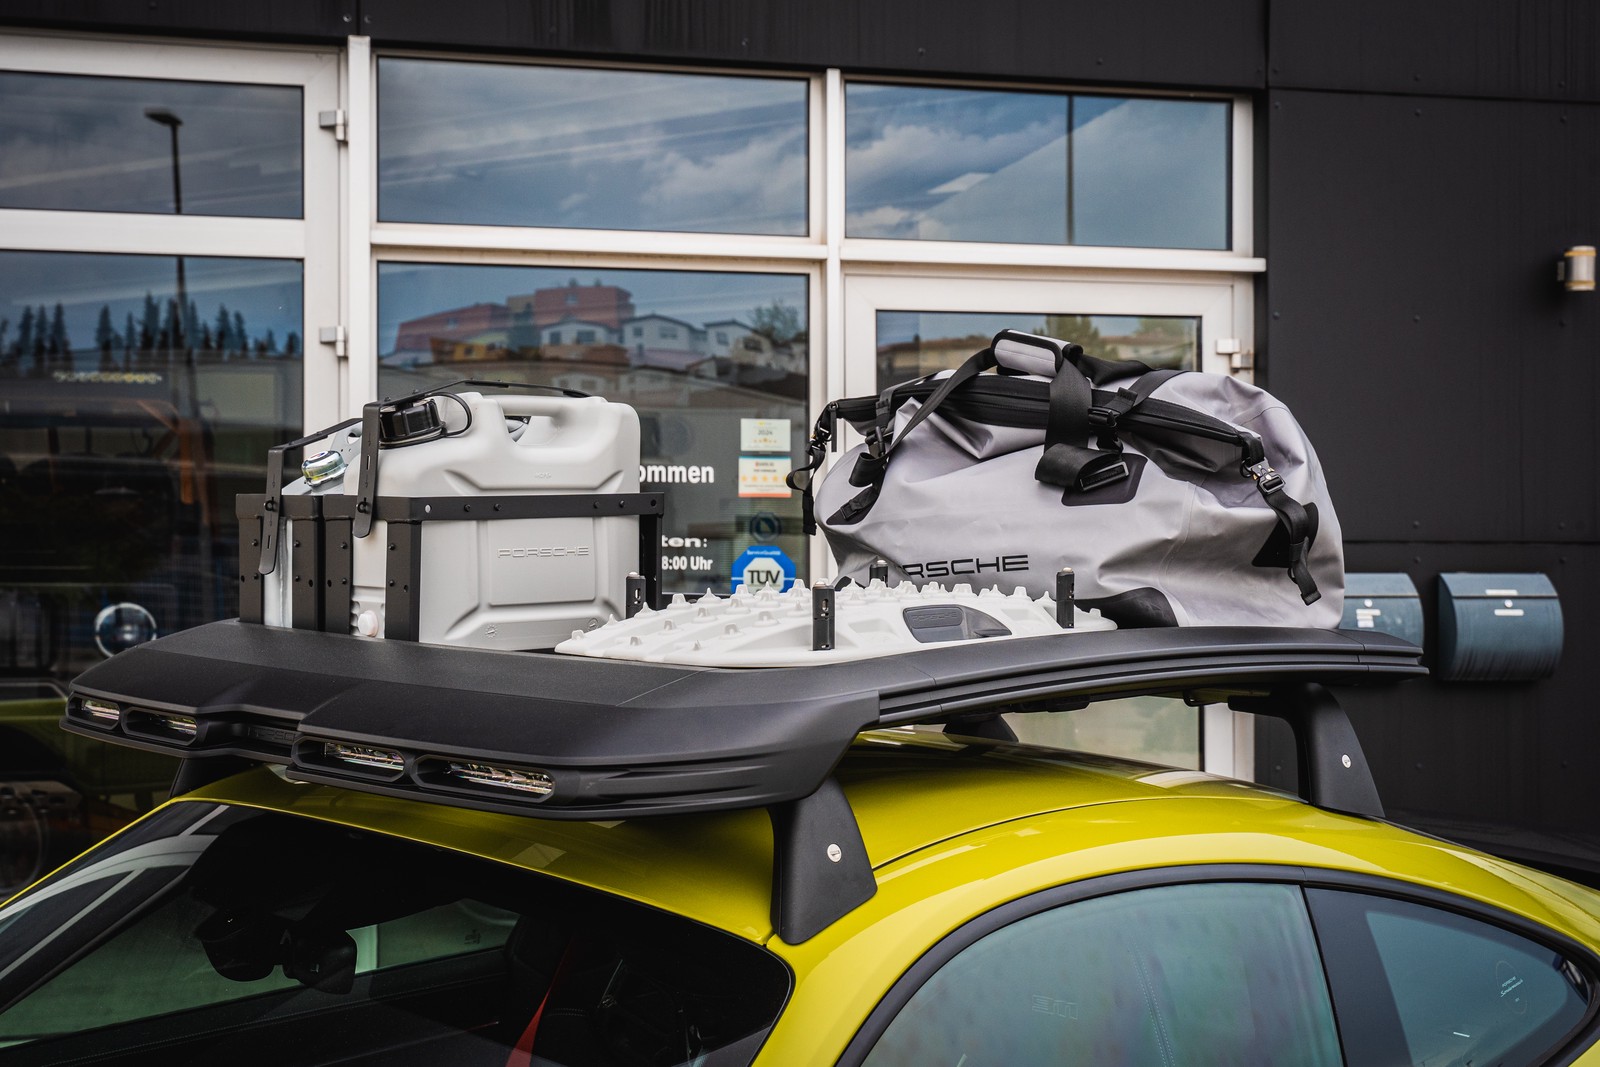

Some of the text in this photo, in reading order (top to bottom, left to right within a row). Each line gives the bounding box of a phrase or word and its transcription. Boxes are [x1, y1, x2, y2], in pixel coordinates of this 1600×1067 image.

[498, 547, 590, 558] PORSCHE
[690, 555, 713, 571] Uhr
[902, 554, 1029, 579] RSCHE
